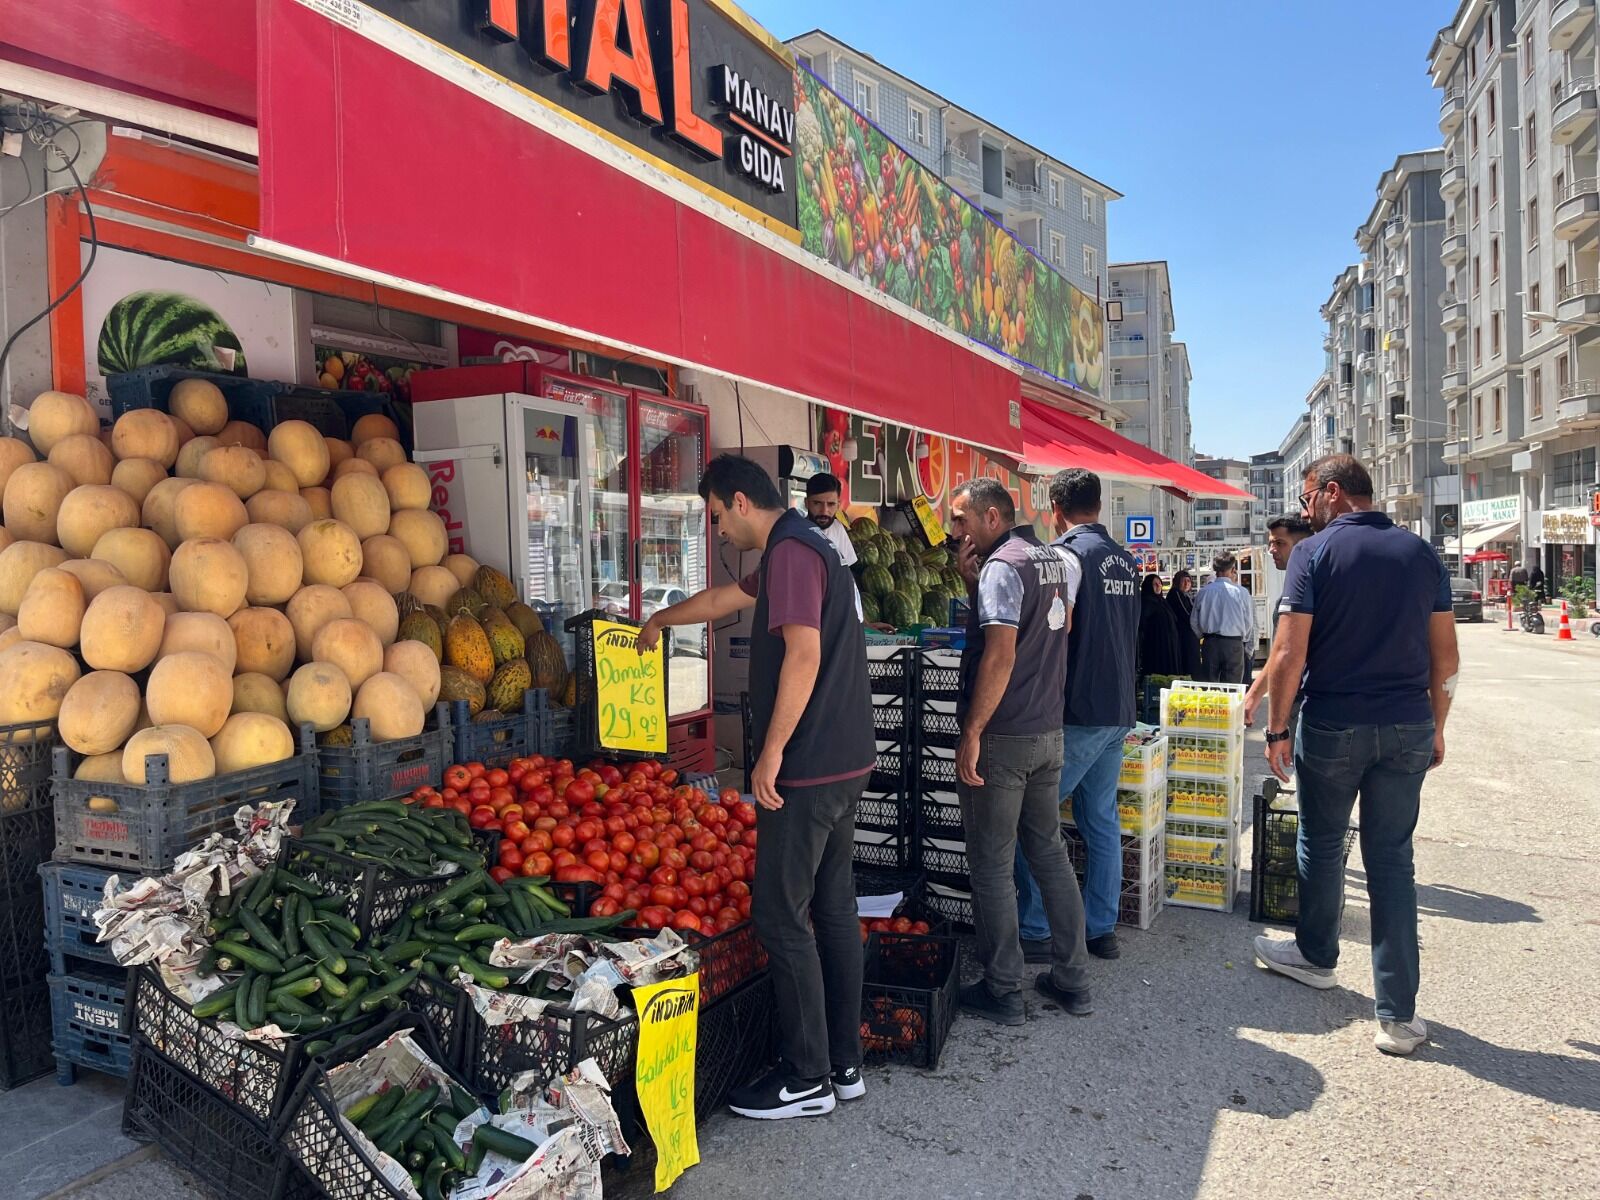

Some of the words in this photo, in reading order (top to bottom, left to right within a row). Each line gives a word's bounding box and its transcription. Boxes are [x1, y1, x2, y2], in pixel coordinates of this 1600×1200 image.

[488, 0, 723, 160] AL
[724, 64, 794, 144] MANAV
[740, 135, 785, 192] GIDA
[1134, 522, 1147, 537] D
[1103, 579, 1135, 596] ZABITA
[630, 683, 655, 706] KG
[75, 1008, 119, 1029] KENT
